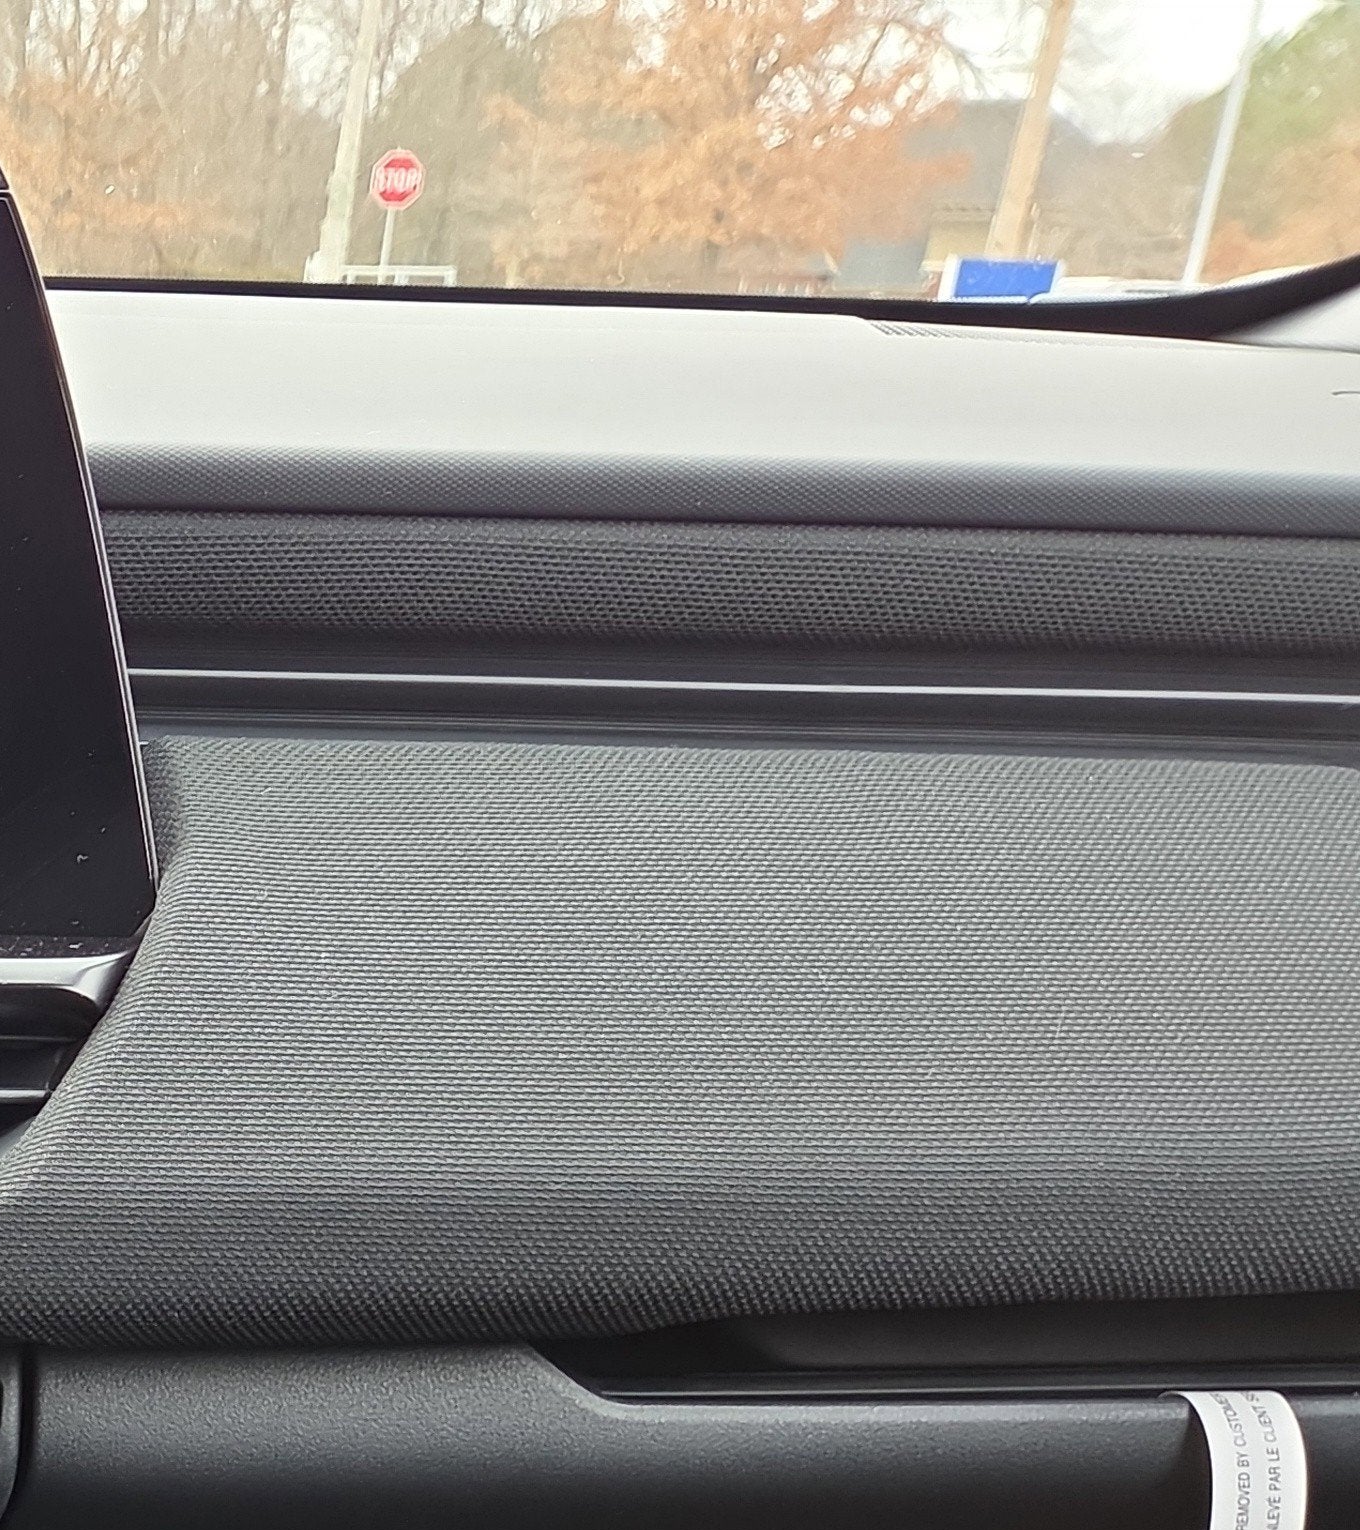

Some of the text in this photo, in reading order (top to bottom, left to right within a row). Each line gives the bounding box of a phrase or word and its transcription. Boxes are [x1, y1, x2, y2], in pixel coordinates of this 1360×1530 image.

[1236, 1451, 1249, 1467] BY
[1266, 1447, 1280, 1461] LE
[1268, 1466, 1281, 1491] PAR
